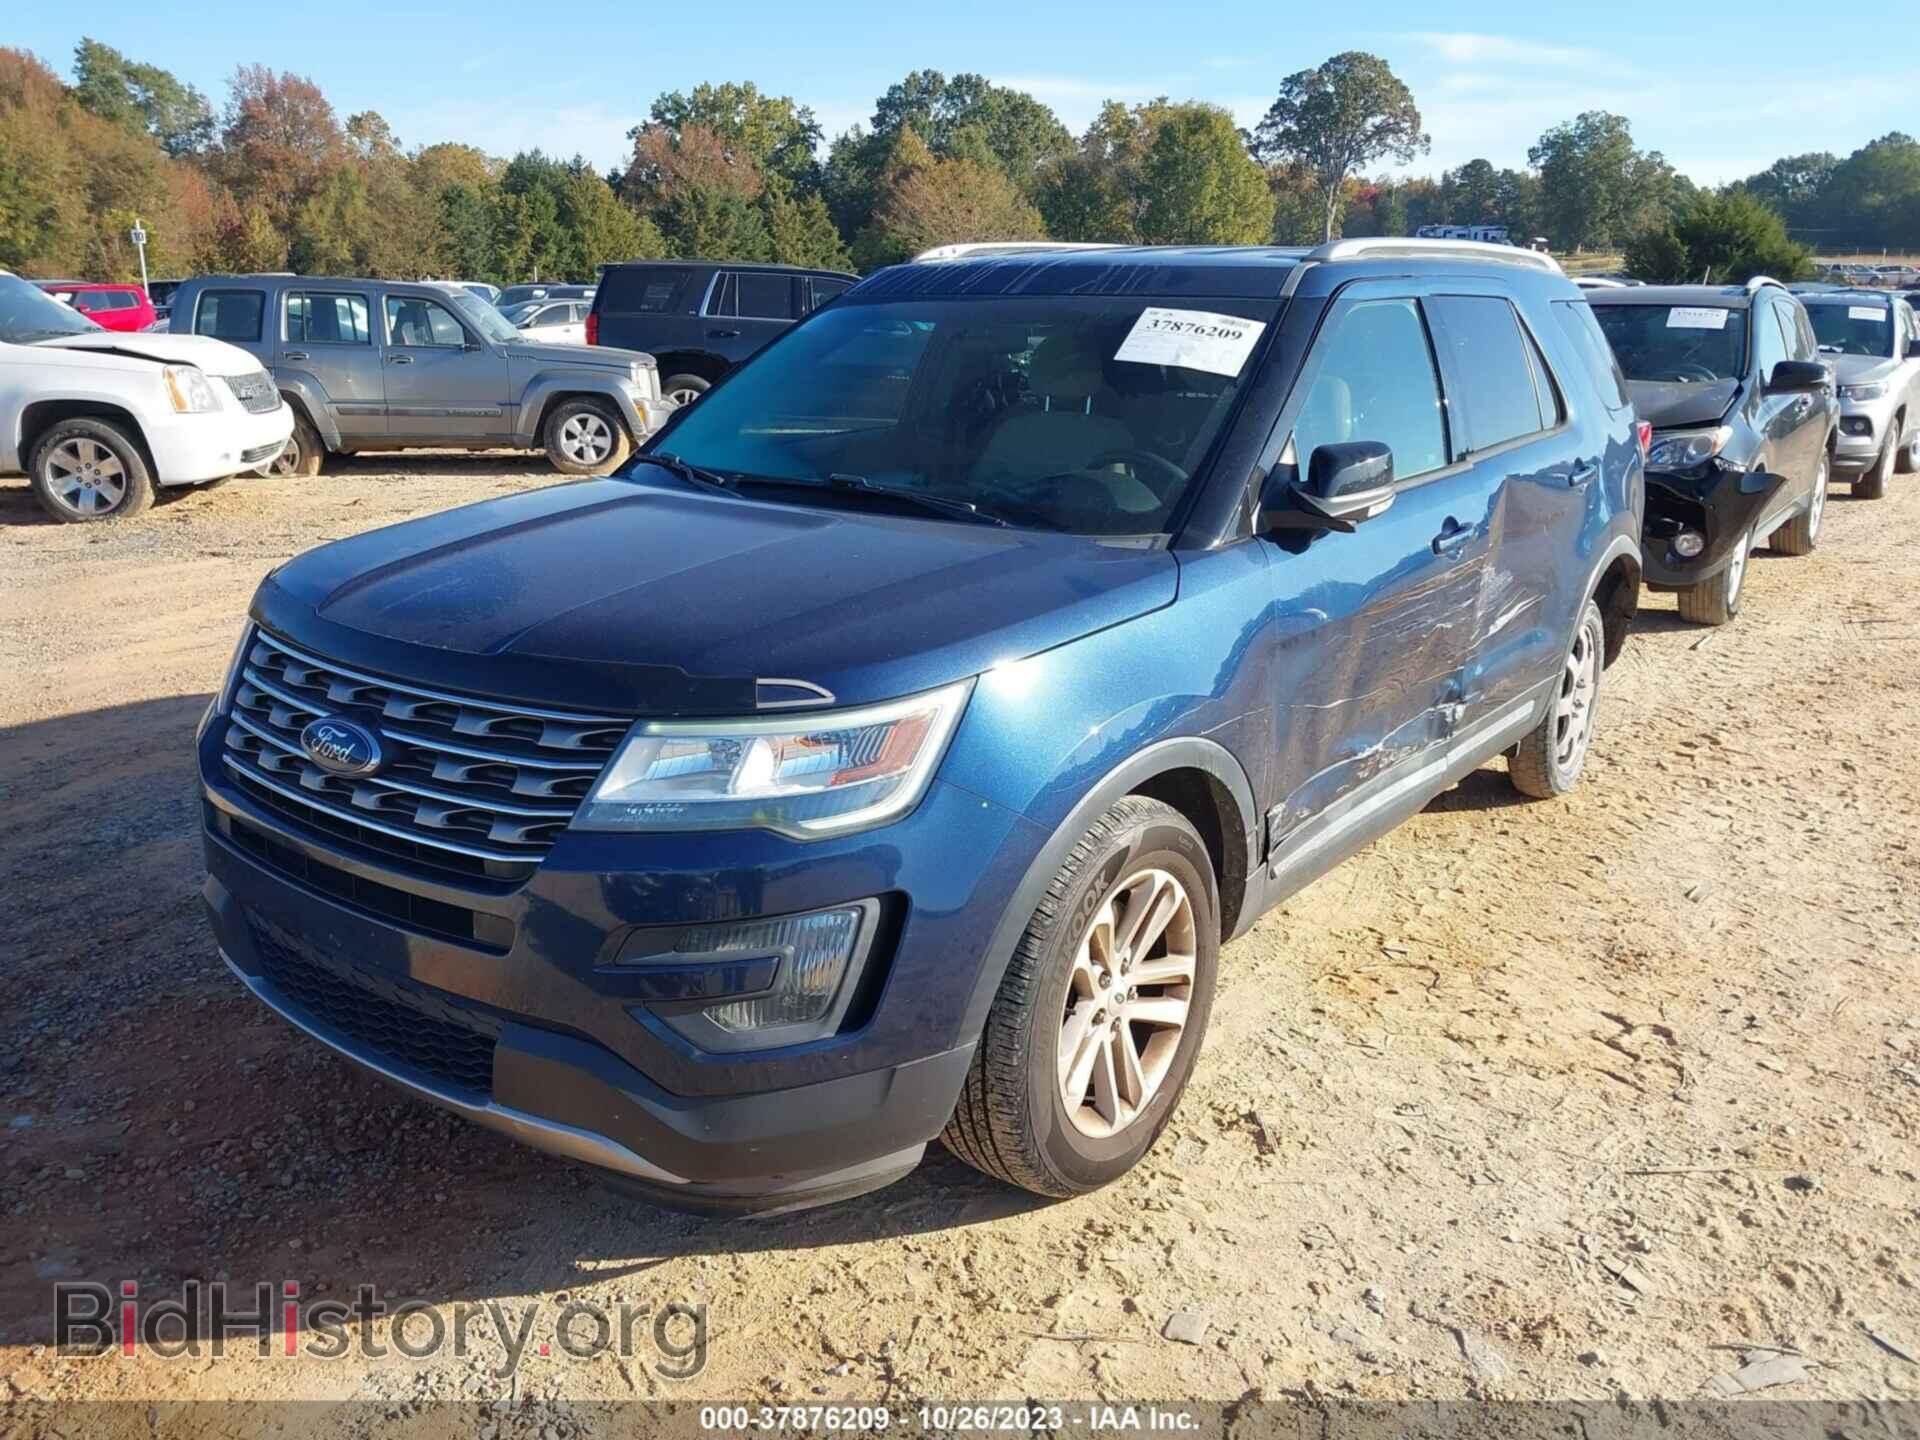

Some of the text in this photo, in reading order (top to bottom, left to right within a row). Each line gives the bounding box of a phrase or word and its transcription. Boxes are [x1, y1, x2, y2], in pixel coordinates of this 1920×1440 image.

[133, 231, 144, 241] 10
[1146, 319, 1243, 341] 37876209
[312, 726, 355, 763] Ford
